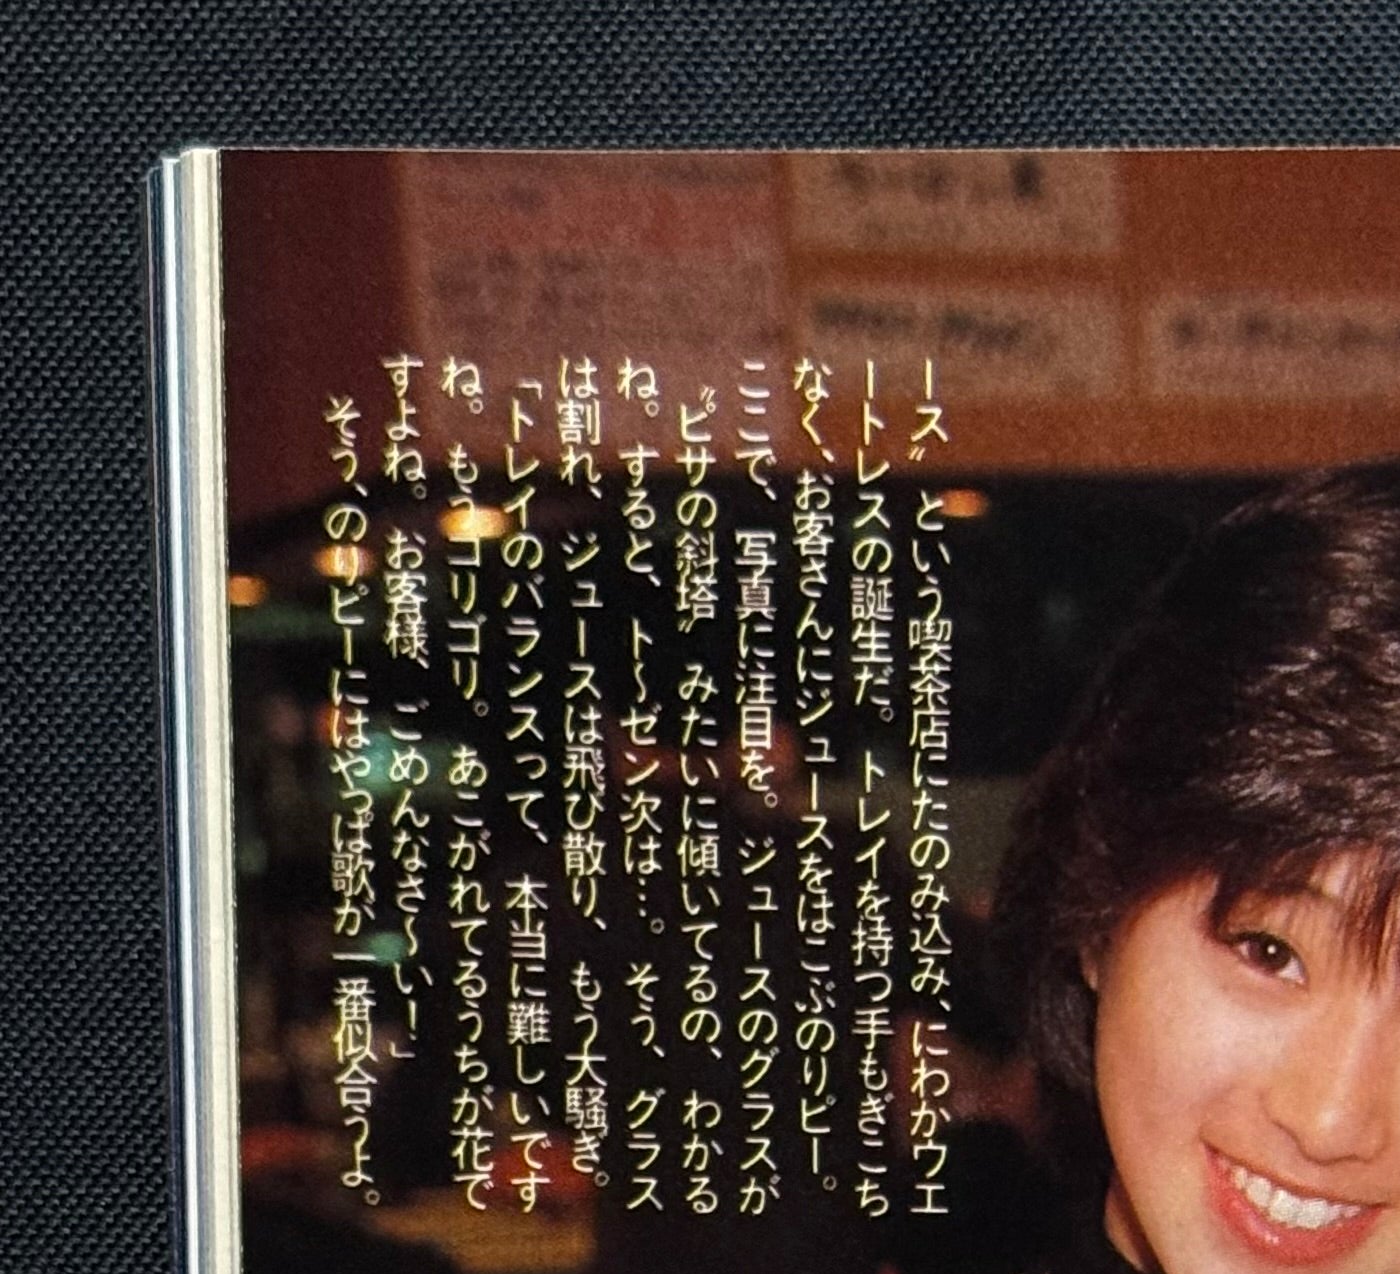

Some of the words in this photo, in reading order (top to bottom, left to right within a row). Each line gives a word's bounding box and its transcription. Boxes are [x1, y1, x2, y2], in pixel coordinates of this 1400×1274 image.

[734, 362, 780, 1213] ここで、写真に注目を。ジュースのグラスが
